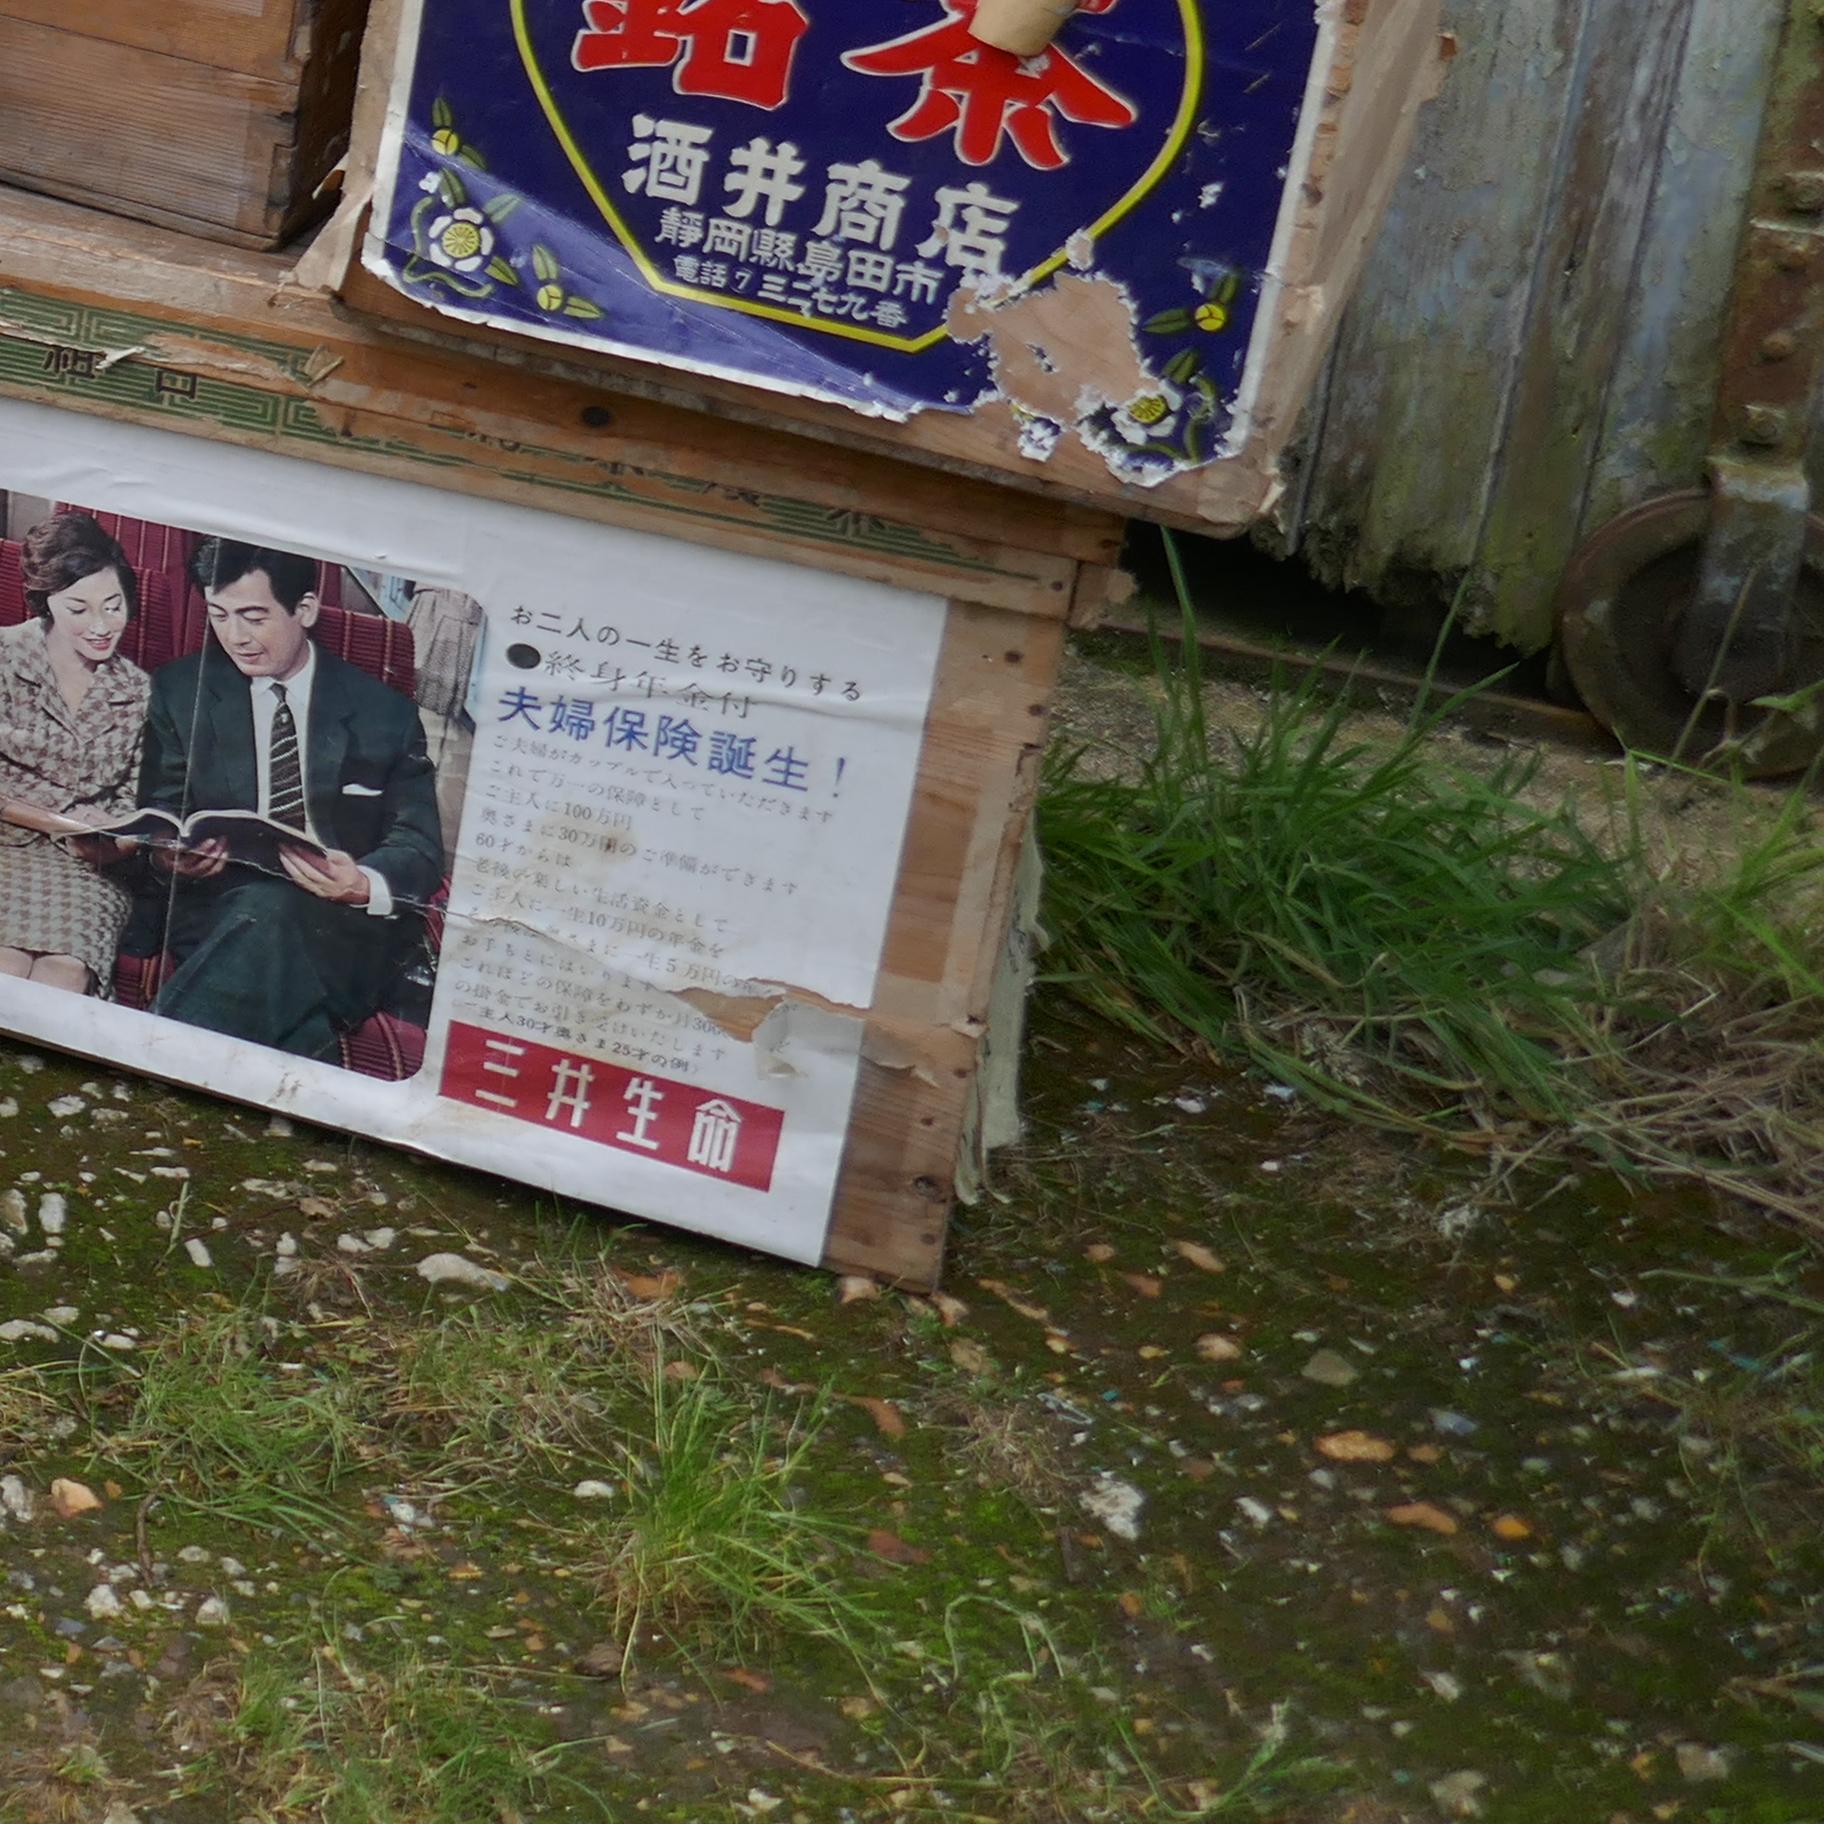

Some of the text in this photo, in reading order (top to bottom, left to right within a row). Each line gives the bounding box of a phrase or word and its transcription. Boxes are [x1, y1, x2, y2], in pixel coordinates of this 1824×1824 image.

[621, 112, 1021, 281] 酒井商店
[510, 604, 863, 703] お二人の一生をお守りする
[497, 685, 848, 799] 夫婦保険誕生！
[484, 783, 633, 832] ご主人に100万円
[476, 1037, 746, 1174] 三井生命
